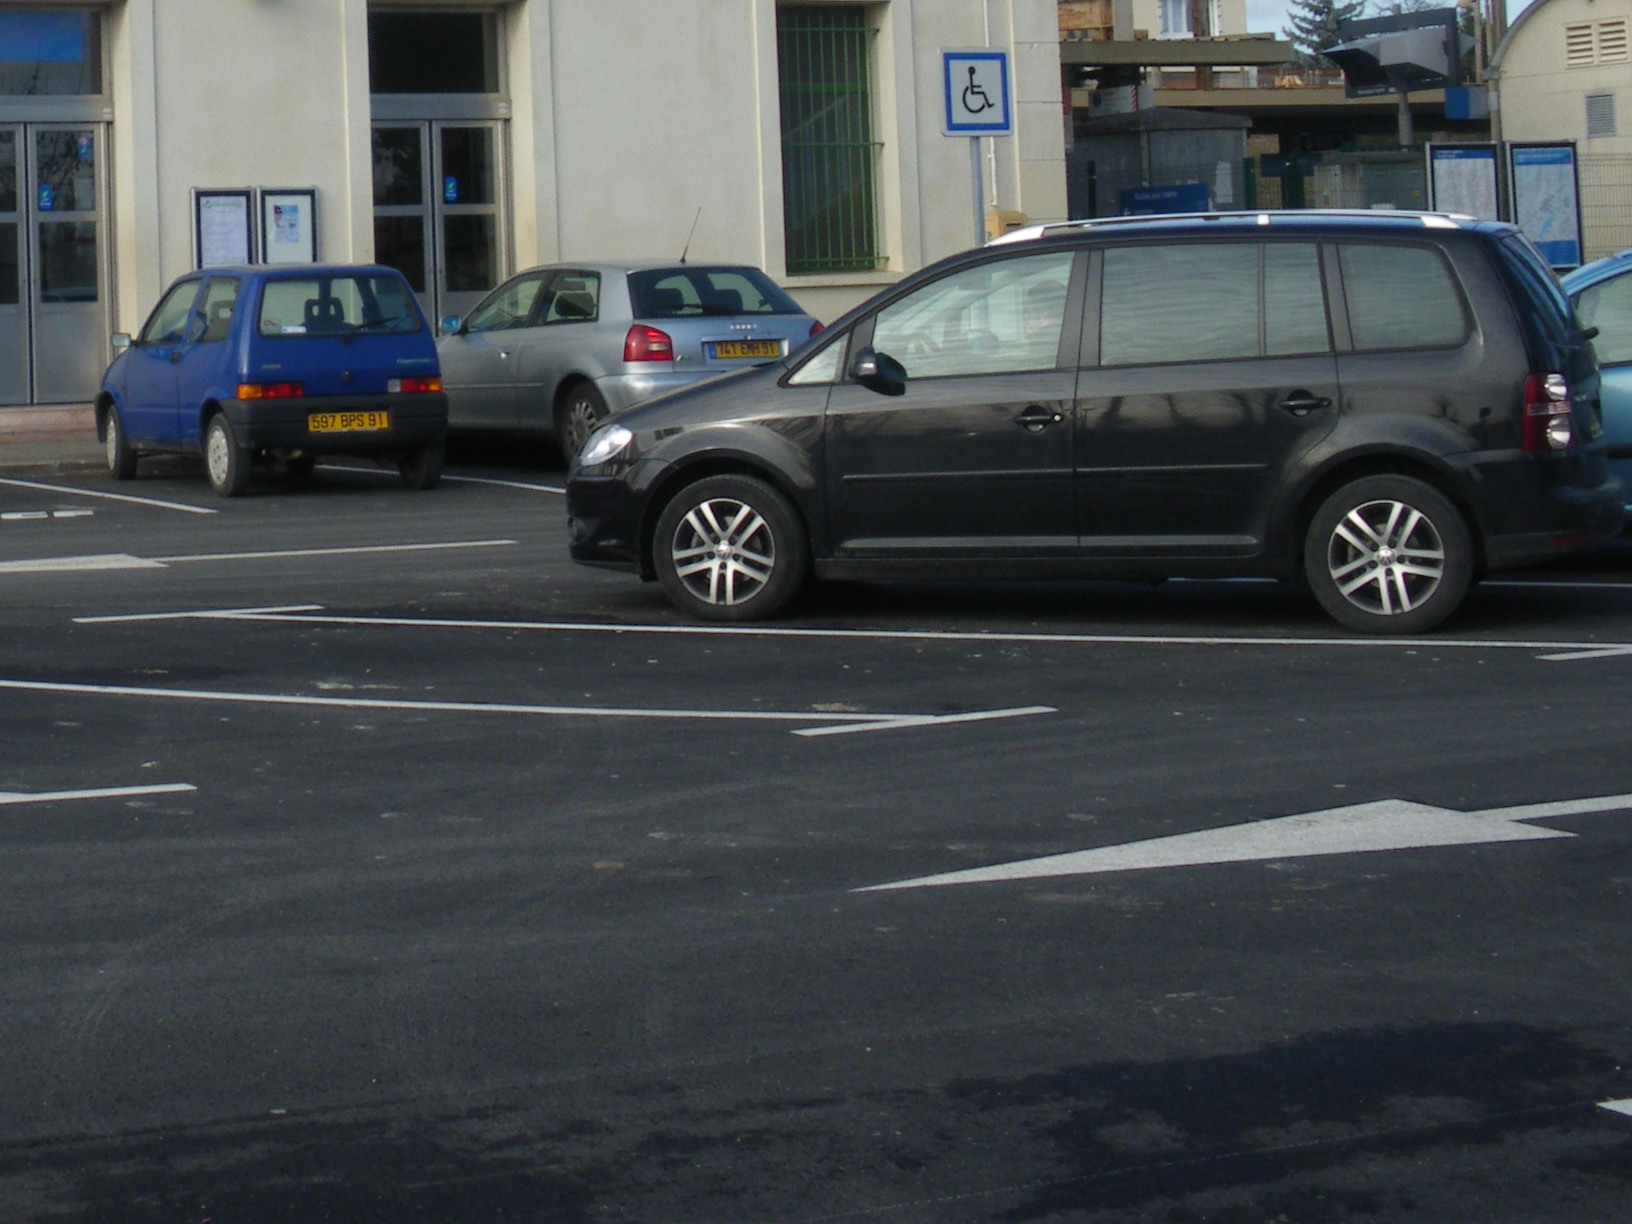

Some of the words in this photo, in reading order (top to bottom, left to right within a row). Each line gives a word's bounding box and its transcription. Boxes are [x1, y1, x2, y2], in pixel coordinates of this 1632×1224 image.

[312, 415, 336, 429] 597
[341, 414, 365, 428] BPS
[368, 413, 383, 427] 91
